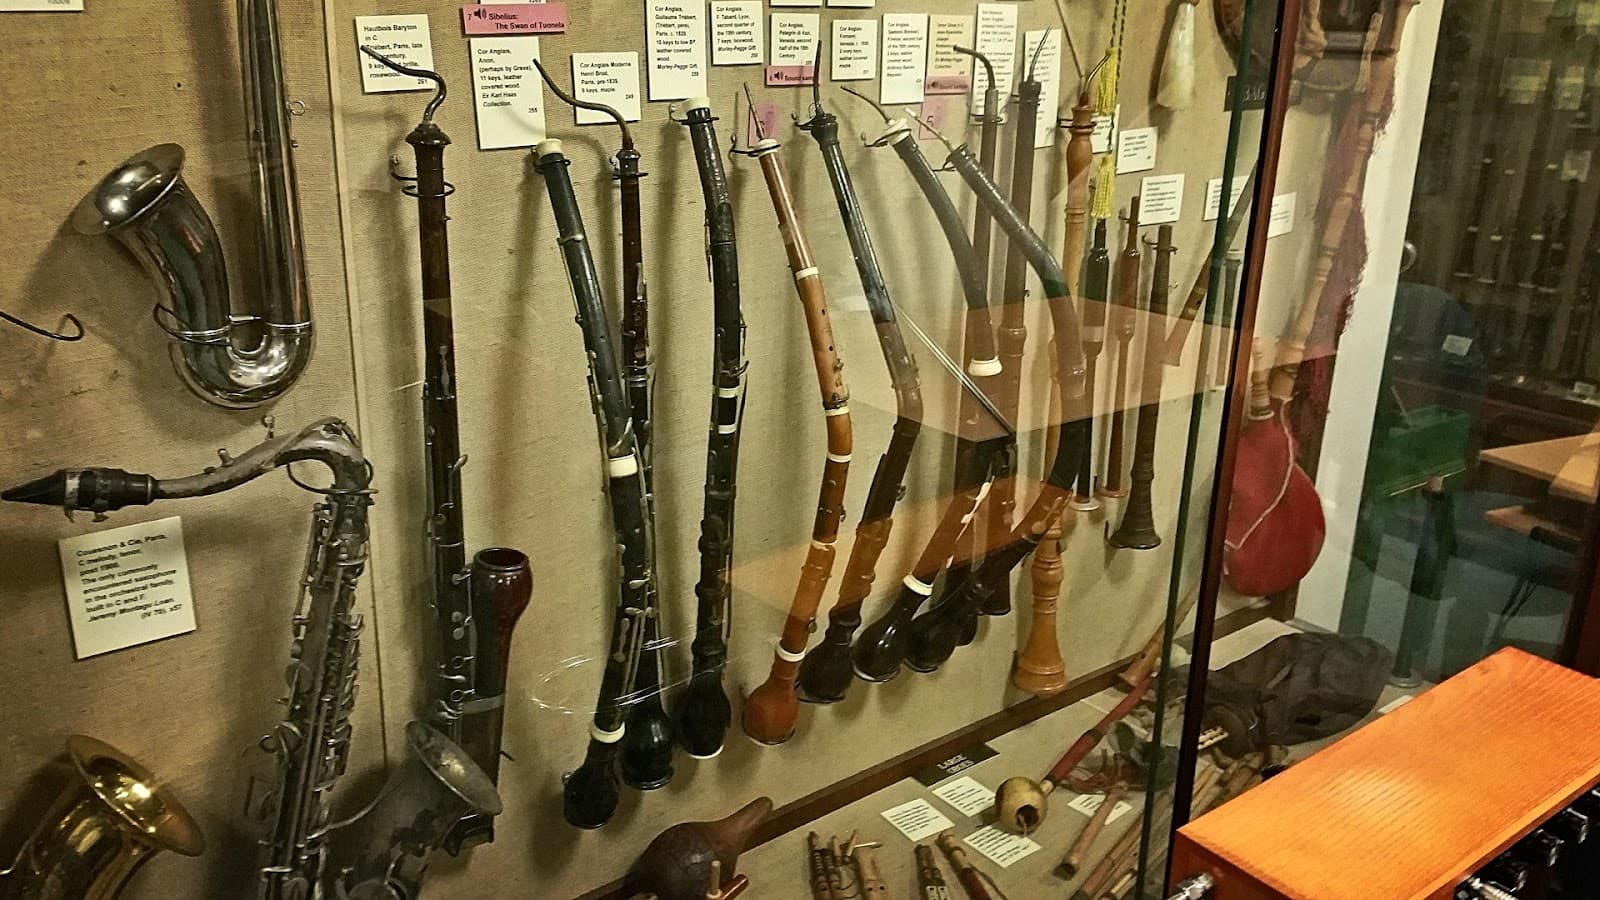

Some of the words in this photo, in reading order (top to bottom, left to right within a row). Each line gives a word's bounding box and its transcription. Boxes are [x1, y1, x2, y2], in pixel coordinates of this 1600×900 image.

[118, 564, 158, 576] commonly
[83, 579, 132, 594] encountered
[135, 570, 176, 582] saxophone
[109, 584, 148, 598] orchestral
[86, 604, 104, 613] built
[88, 612, 116, 622] Jeremy
